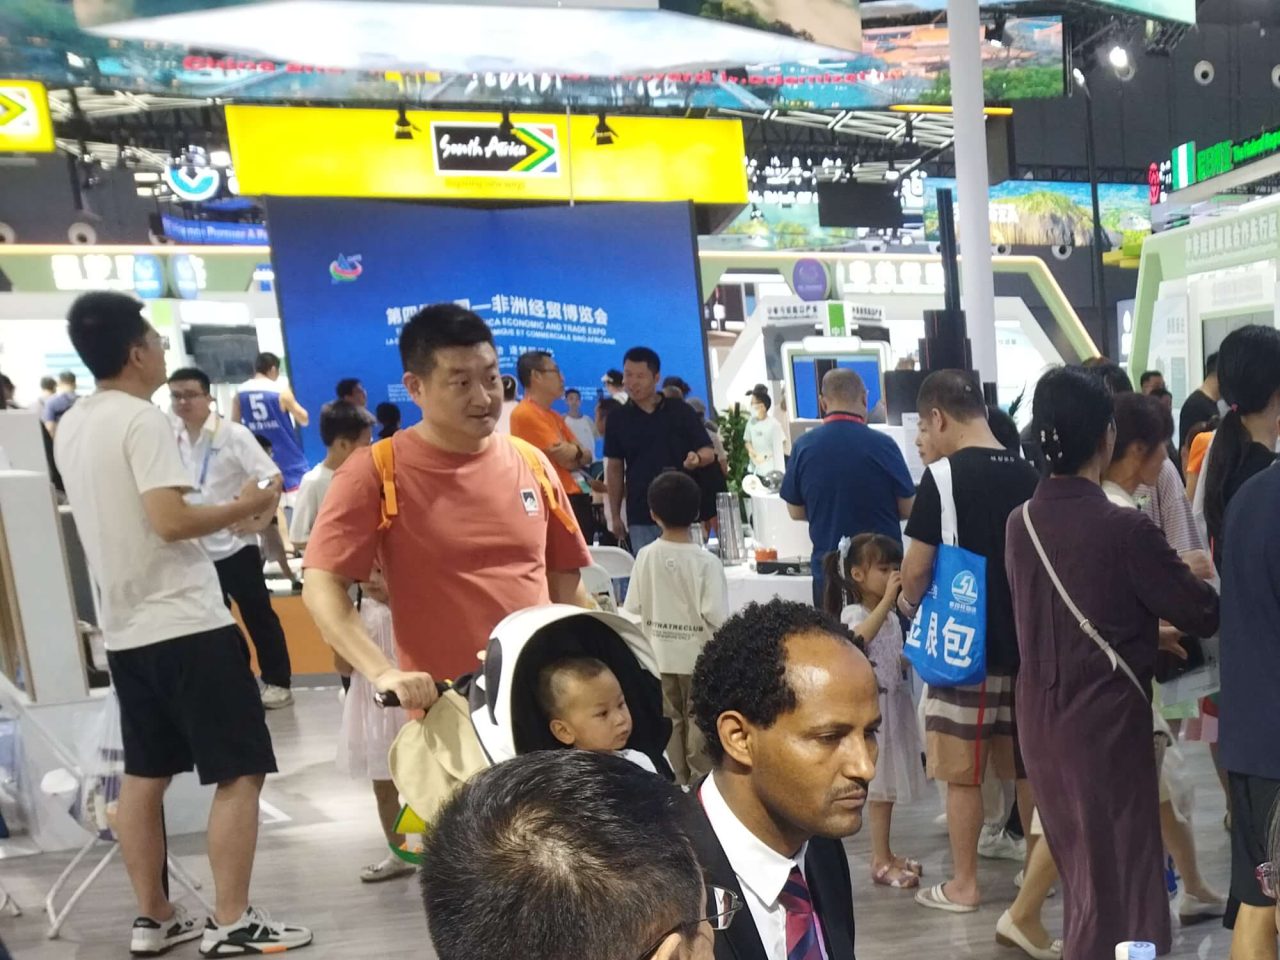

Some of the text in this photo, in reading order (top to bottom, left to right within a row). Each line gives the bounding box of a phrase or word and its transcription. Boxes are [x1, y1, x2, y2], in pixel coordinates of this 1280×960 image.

[440, 133, 527, 159] South Africa
[386, 294, 609, 326] 第四—非洲经贸博览会
[249, 393, 269, 421] 5
